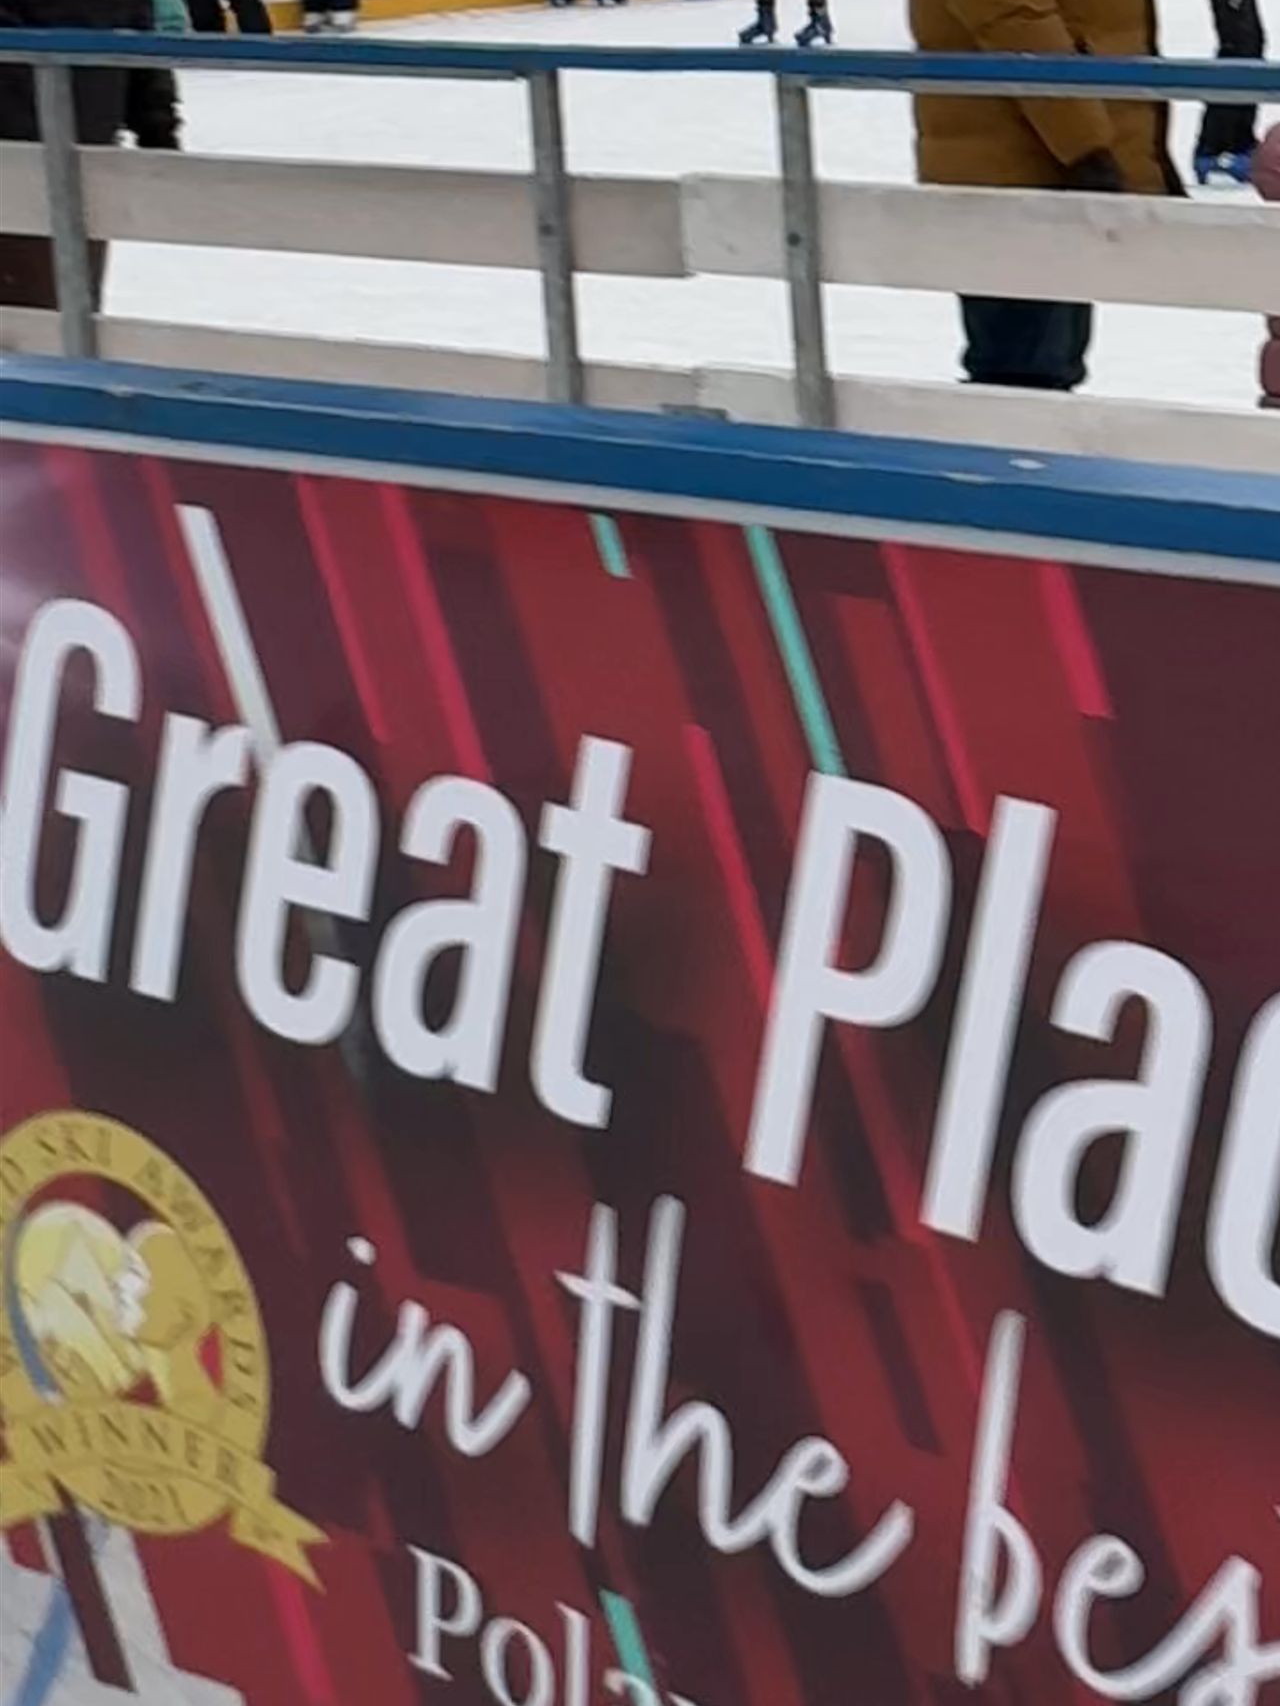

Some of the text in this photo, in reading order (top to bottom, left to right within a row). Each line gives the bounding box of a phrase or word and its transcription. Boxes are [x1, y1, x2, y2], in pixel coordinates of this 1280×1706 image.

[0, 596, 654, 1130] Great
[29, 1408, 243, 1494] WINNER
[99, 1465, 191, 1528] 2021
[318, 1234, 529, 1458] in
[553, 1194, 911, 1597] the
